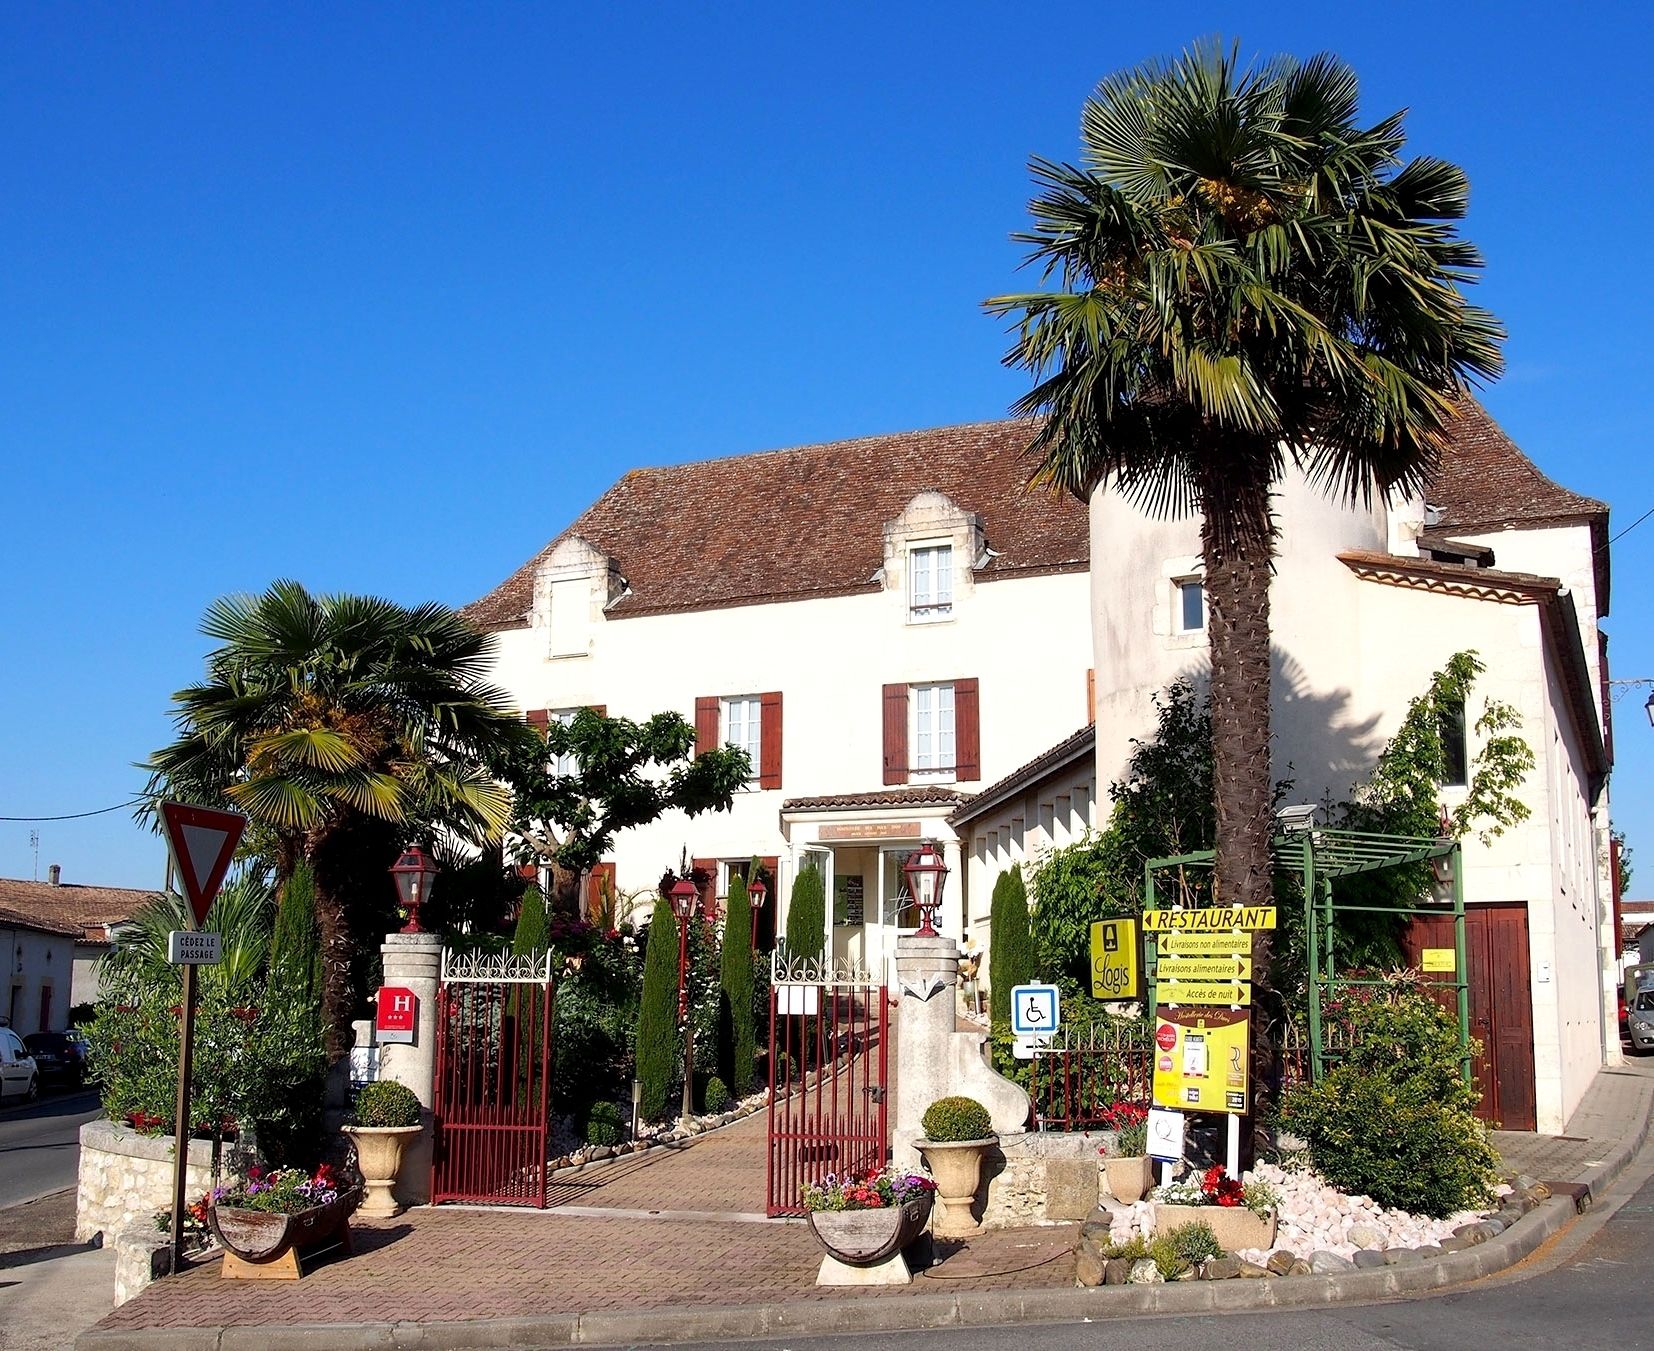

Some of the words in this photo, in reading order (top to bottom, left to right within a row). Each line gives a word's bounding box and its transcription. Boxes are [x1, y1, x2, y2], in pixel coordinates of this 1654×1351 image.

[1157, 908, 1271, 929] RESTAURANT
[180, 935, 204, 947] CÉDEZ
[206, 938, 215, 947] LE
[1170, 940, 1199, 949] Livraisons
[1212, 940, 1248, 949] alimentaires
[180, 950, 213, 959] PASSAGE
[1093, 953, 1129, 994] Logis
[1159, 964, 1191, 973] Livraisons
[1193, 964, 1235, 973] alimentaires
[1186, 989, 1206, 999] Accès
[1210, 989, 1217, 999] de
[1218, 990, 1232, 999] nuit
[393, 995, 410, 1012] H
